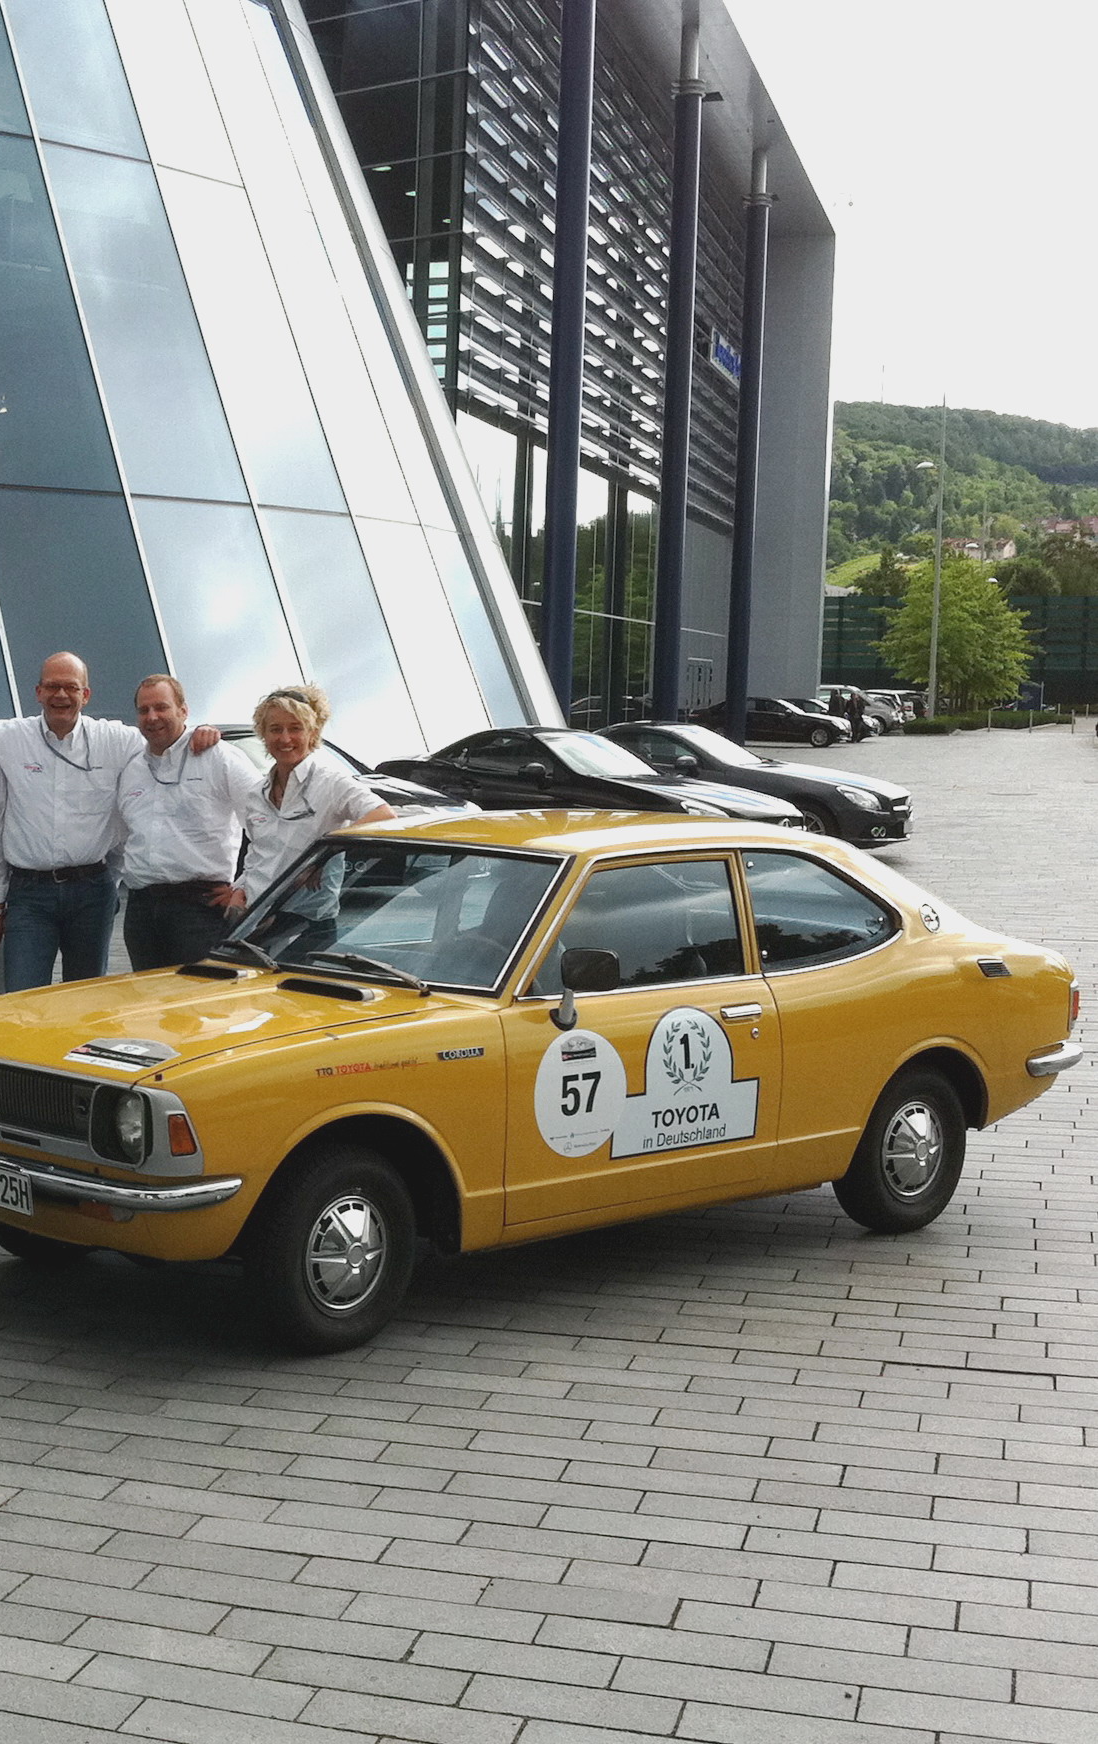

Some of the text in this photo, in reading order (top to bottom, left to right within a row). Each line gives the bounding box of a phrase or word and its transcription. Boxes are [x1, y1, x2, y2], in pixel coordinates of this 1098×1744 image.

[442, 1049, 480, 1061] COROLLA
[334, 1062, 372, 1076] TOYOTA
[560, 1070, 602, 1117] 57
[652, 1103, 720, 1128] TOYOTA
[642, 1123, 727, 1150] in Deutschland
